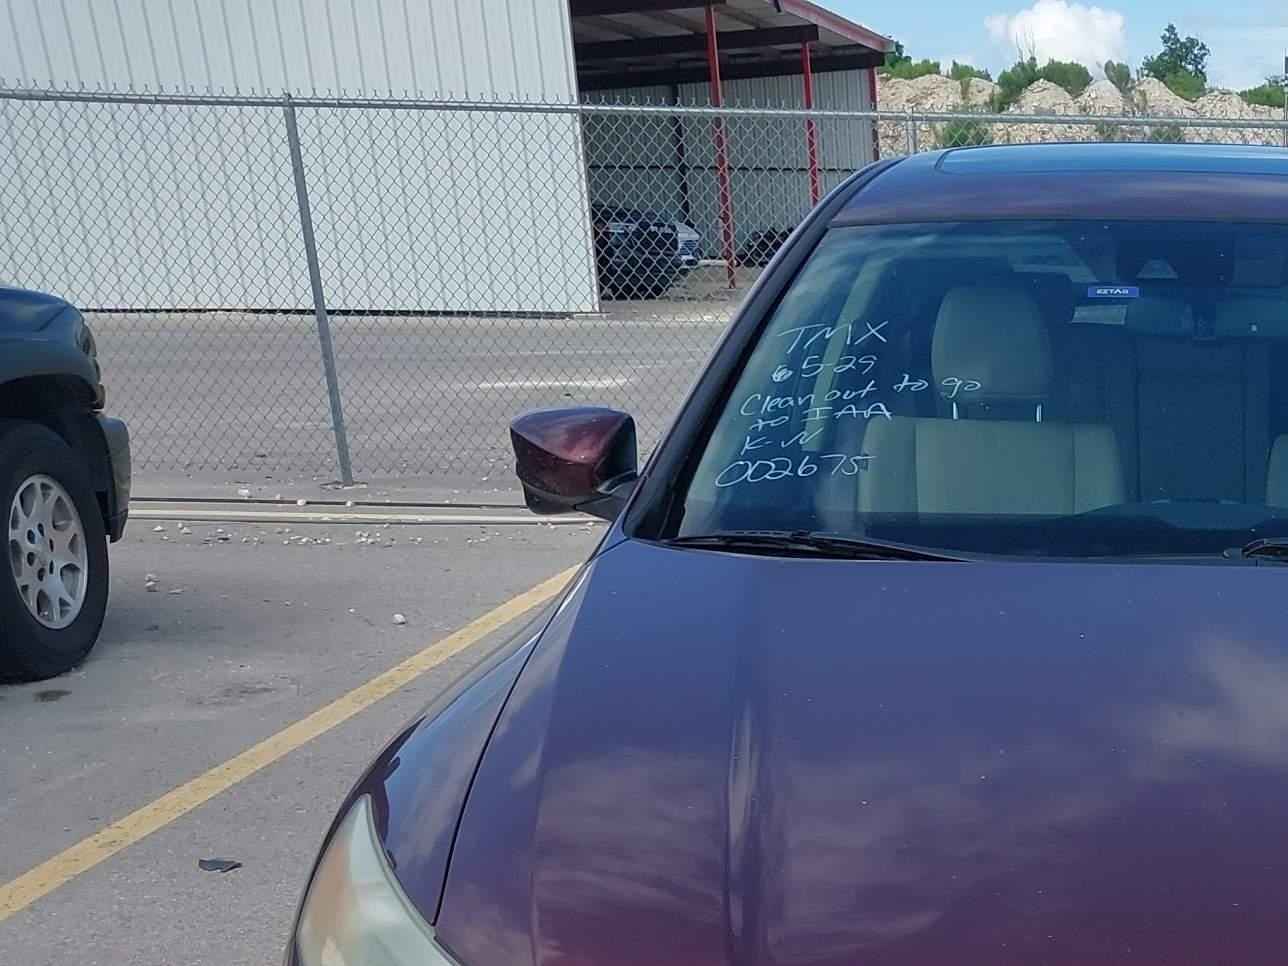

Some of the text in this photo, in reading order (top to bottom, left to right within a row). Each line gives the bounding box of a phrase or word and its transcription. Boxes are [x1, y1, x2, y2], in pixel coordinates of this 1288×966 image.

[776, 320, 889, 354] TMX
[740, 373, 982, 416] Clean out to go
[748, 402, 892, 432] to IAA
[715, 454, 876, 487] 002675
